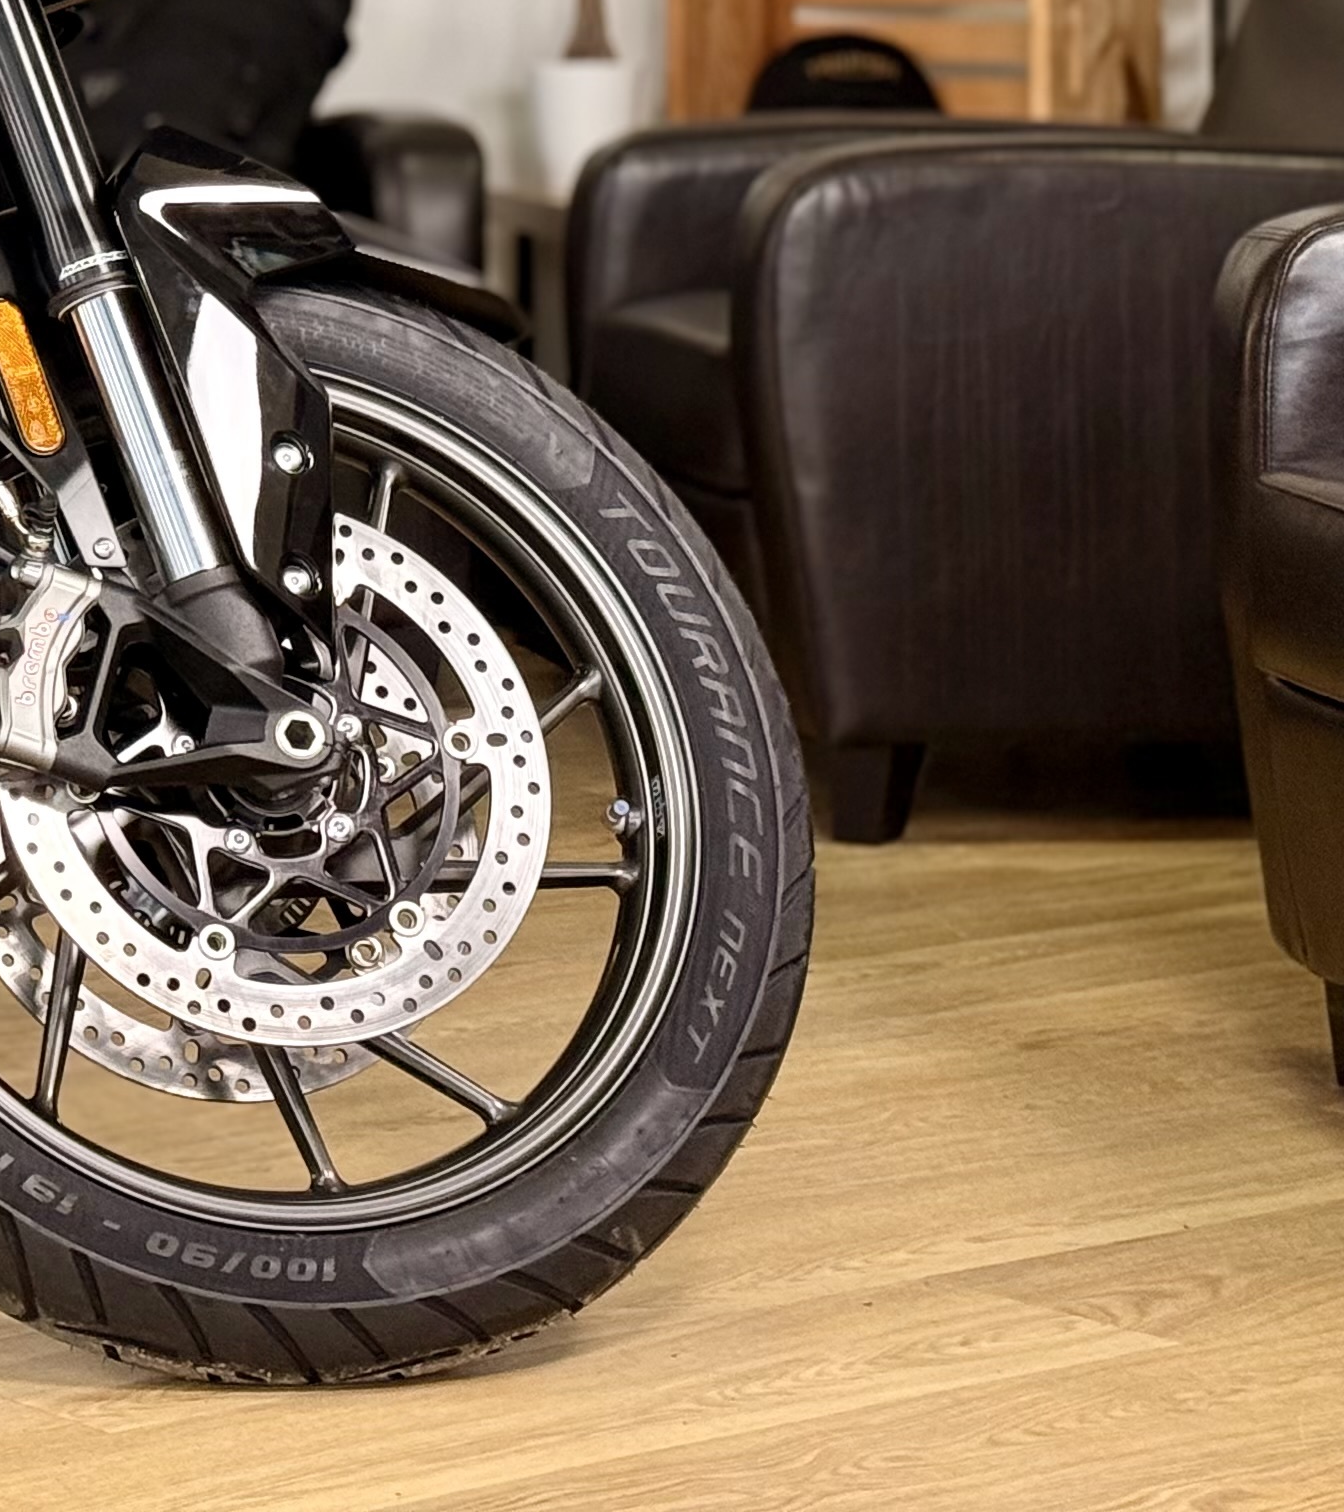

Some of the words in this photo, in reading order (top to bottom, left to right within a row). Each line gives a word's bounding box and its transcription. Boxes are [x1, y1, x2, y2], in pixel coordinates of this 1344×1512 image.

[14, 607, 60, 707] brembo
[598, 491, 763, 896] TOURANCE
[21, 1174, 78, 1216] 19
[144, 1230, 337, 1283] 100/90
